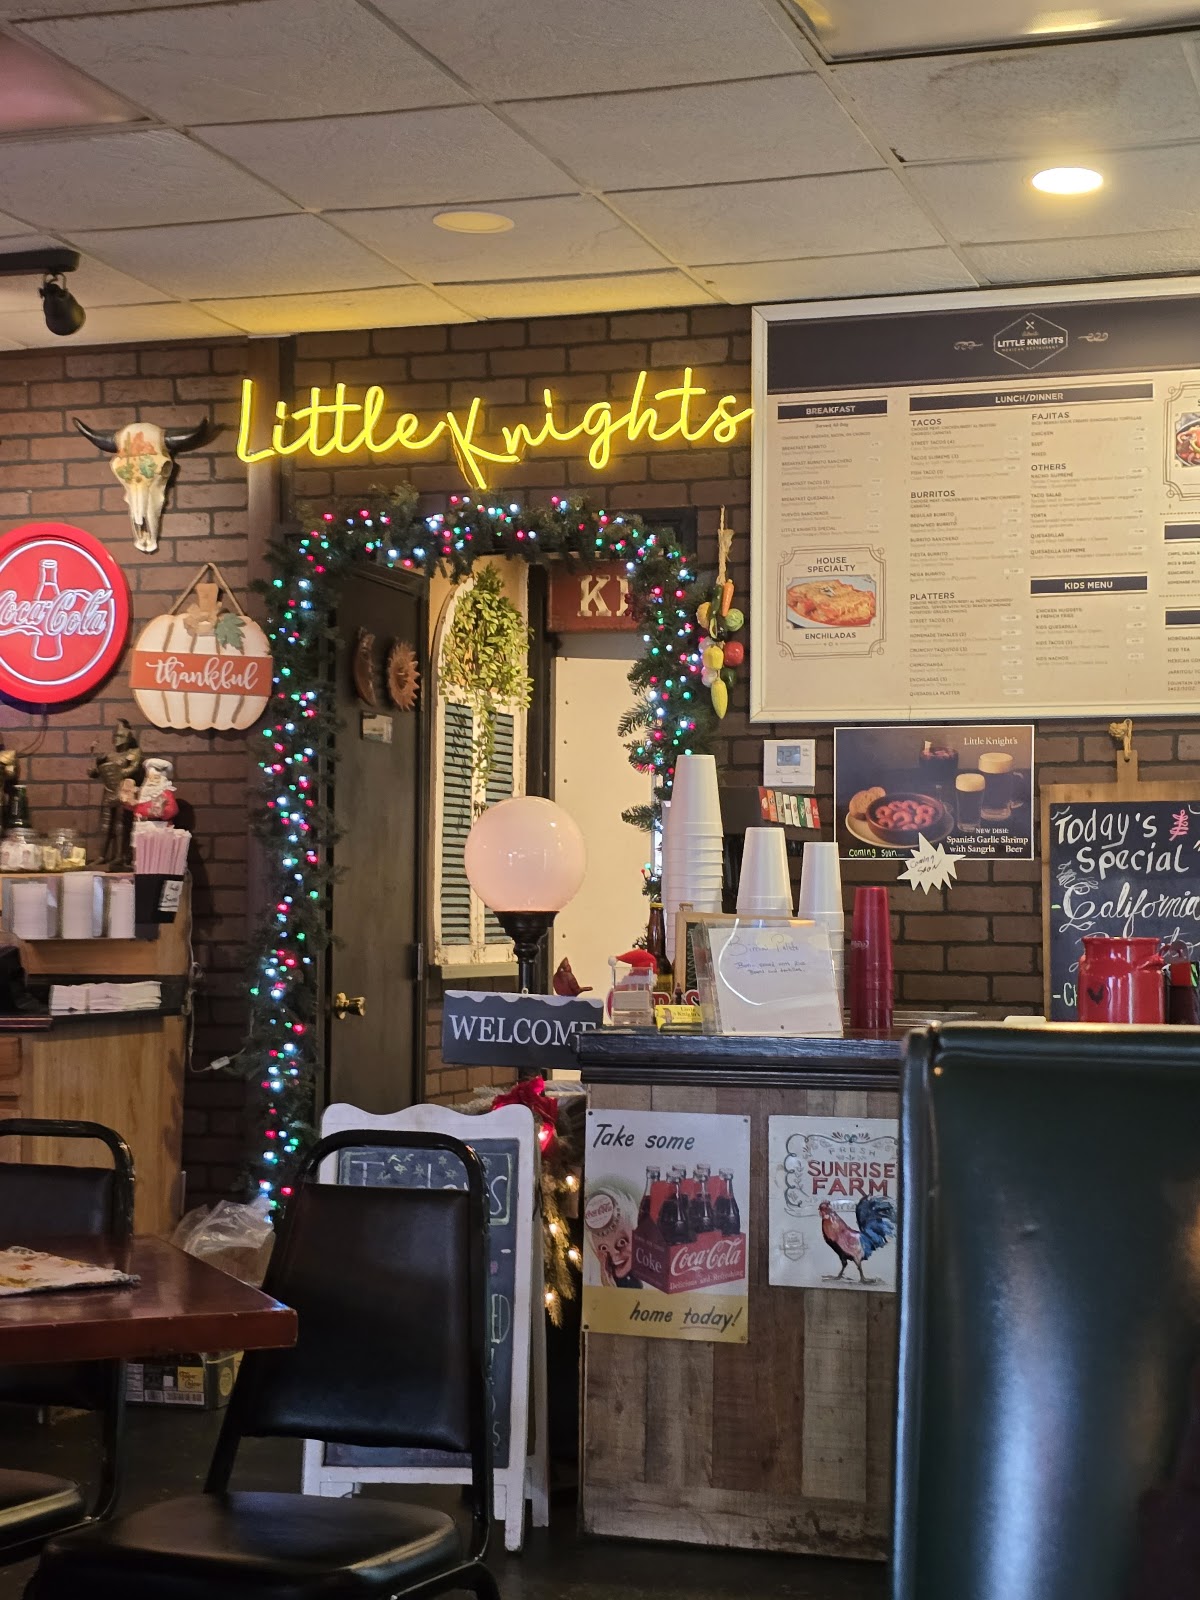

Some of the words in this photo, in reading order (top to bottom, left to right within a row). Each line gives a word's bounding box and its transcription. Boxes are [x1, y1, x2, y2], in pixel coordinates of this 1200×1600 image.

[997, 339, 1026, 348] LITTLE
[1026, 336, 1064, 346] KNIGHTS
[995, 393, 1064, 403] LUNCH/DINNER
[806, 406, 856, 415] BREAKFAST
[1032, 412, 1070, 420] FAJITAS
[911, 418, 942, 426] TACOS
[236, 378, 448, 464] Little
[446, 367, 754, 490] Knights
[1031, 463, 1066, 472] OTHERS
[910, 490, 956, 498] BURRITOS
[816, 556, 847, 564] HOUSE
[808, 564, 856, 573] SPECIALTY
[1064, 582, 1085, 590] KIDS
[1088, 580, 1113, 588] MENU
[910, 592, 954, 600] PLATTERS
[805, 632, 856, 640] ENCHILADAS
[146, 656, 259, 690] thankful
[964, 736, 984, 745] Little
[985, 736, 1018, 746] Knight's
[1055, 808, 1158, 850] Today's
[946, 836, 976, 844] Spanish
[976, 836, 999, 844] Garlic
[1000, 836, 1029, 845] Shrimp
[849, 849, 876, 858] Coming
[950, 845, 966, 853] with
[968, 845, 996, 854] Sangria
[1006, 845, 1024, 853] Beer
[910, 854, 935, 868] Coming
[1076, 842, 1190, 880] Special
[1059, 882, 1200, 938] California
[592, 1123, 635, 1148] Take
[645, 1134, 695, 1150] some
[829, 1147, 876, 1157] FRESH
[808, 1160, 895, 1178] SUNRISE
[812, 1178, 888, 1196] FARM
[636, 1247, 662, 1273] Coke
[670, 1238, 742, 1277] Coca-Cola
[630, 1301, 673, 1323] home
[682, 1306, 743, 1333] today!
